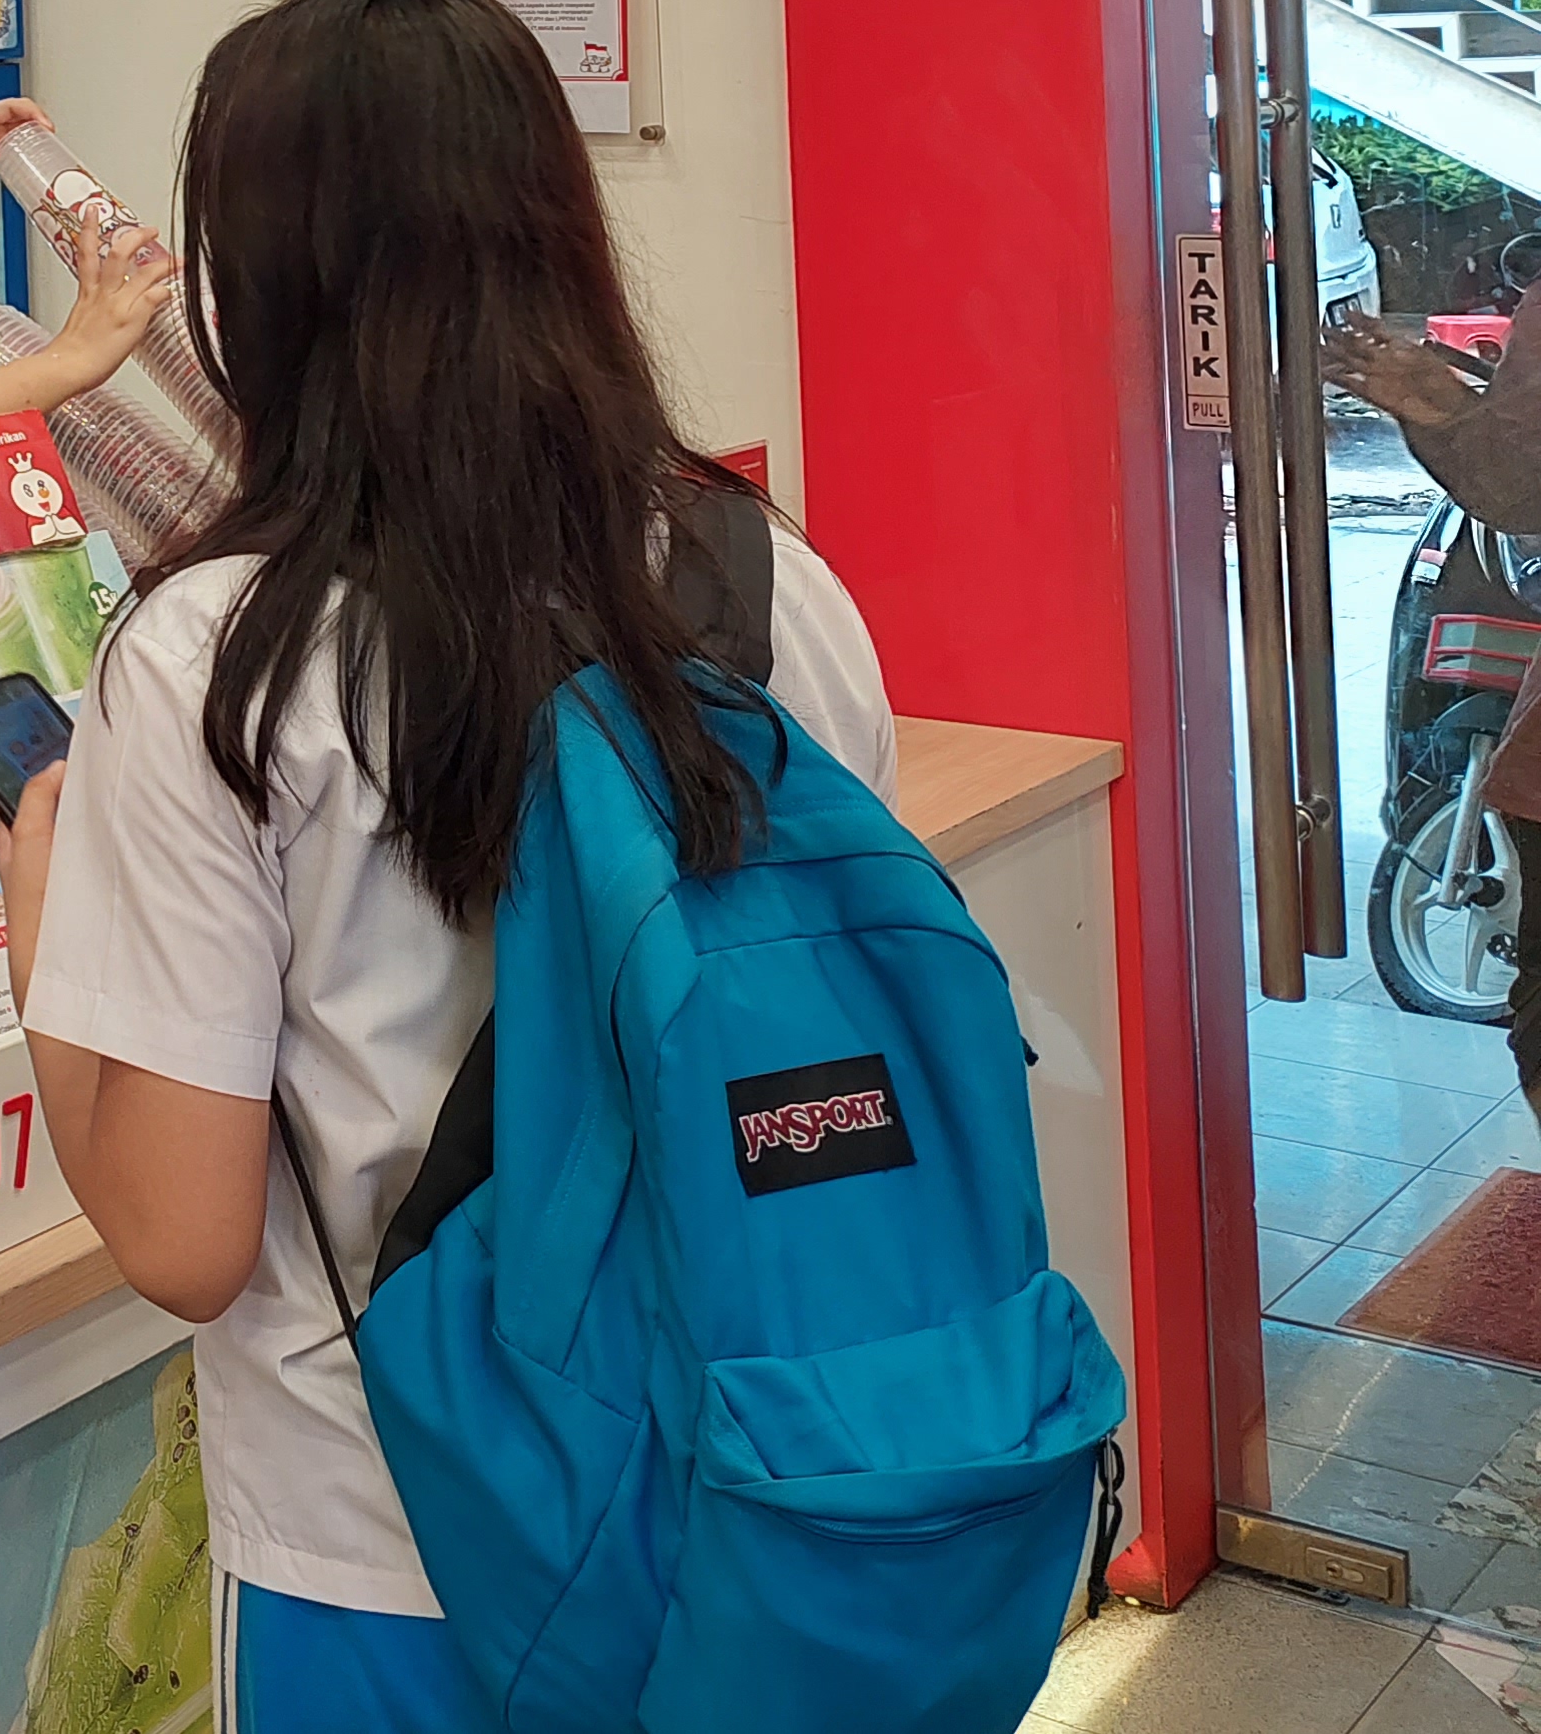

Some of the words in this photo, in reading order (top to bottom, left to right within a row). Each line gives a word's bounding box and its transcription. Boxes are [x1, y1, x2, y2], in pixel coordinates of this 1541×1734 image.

[1187, 252, 1219, 378] TARIK
[1192, 402, 1225, 419] PULL
[739, 1090, 887, 1162] JANSPORT
